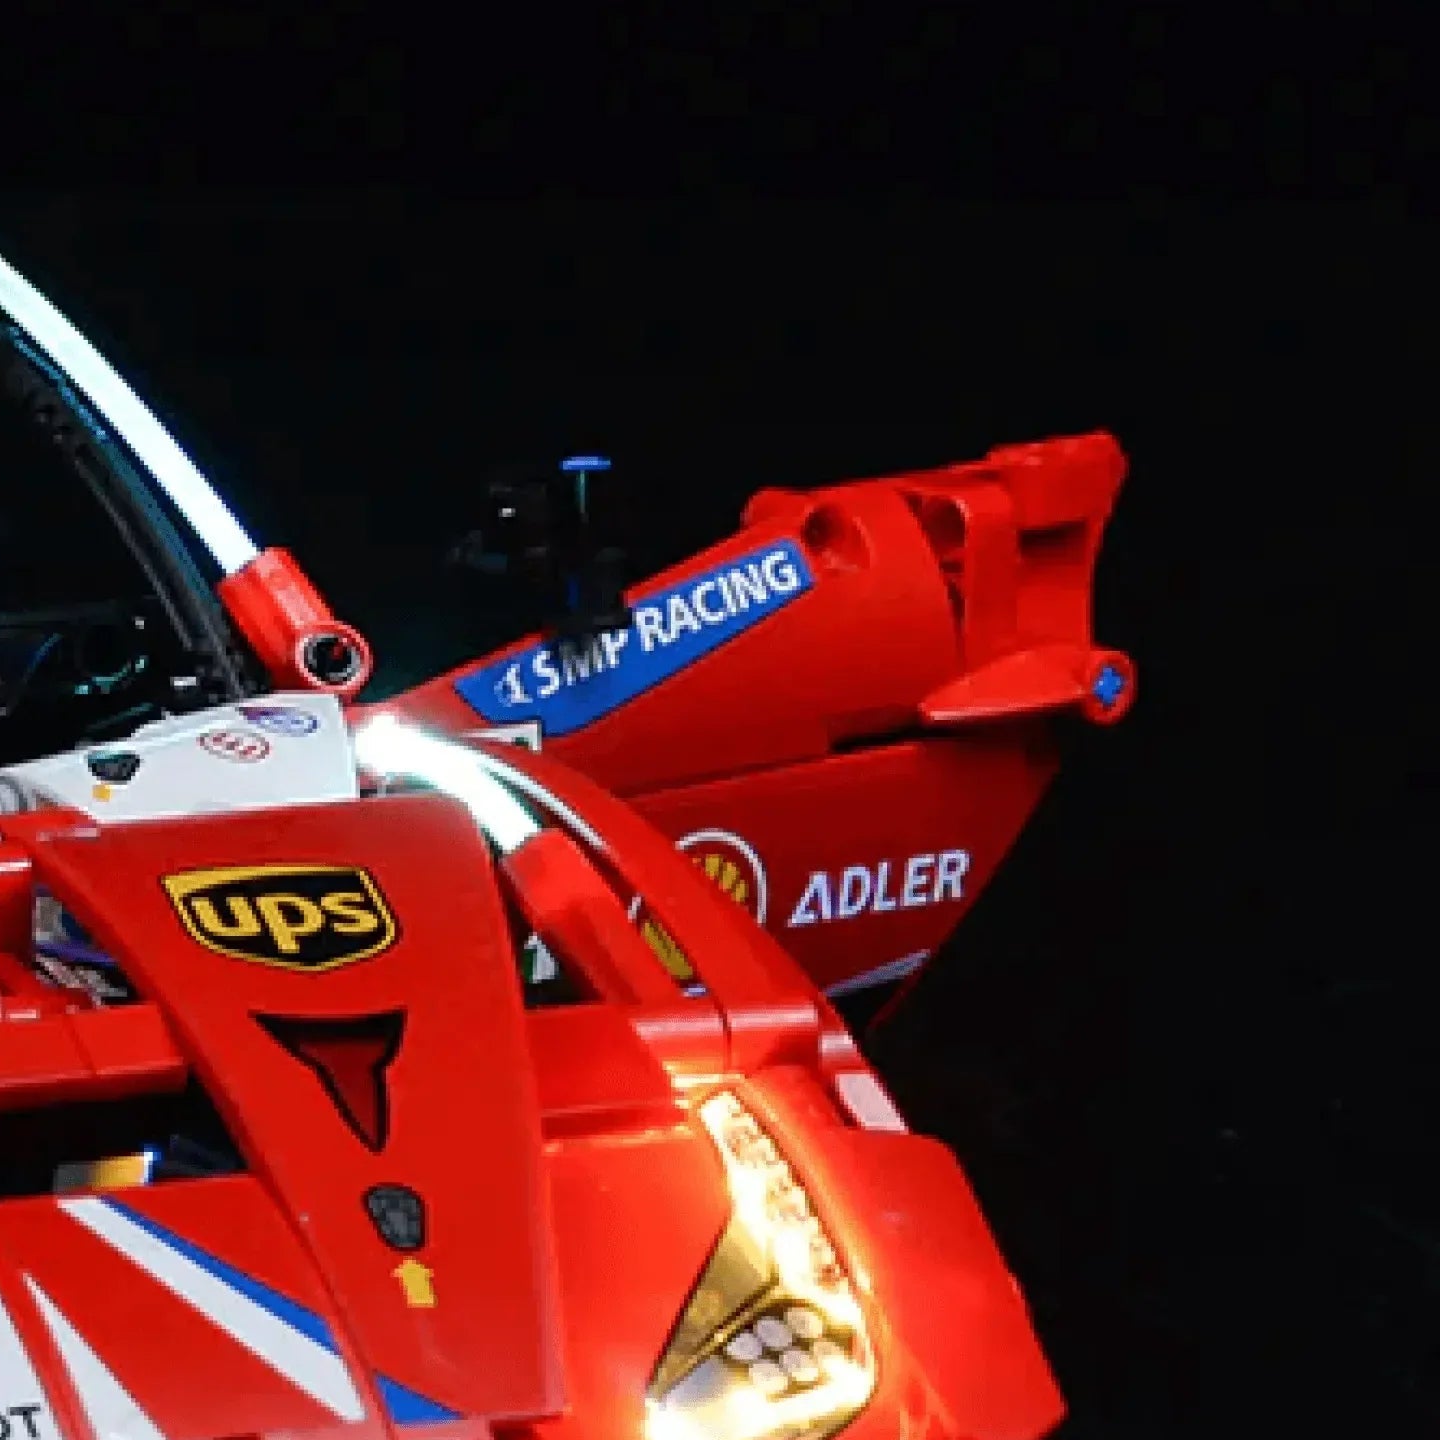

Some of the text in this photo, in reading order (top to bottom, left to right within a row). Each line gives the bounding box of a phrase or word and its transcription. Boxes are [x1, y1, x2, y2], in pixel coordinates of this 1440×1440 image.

[634, 551, 798, 652] RACING
[190, 892, 379, 954] ups
[787, 849, 971, 928] ADLER
